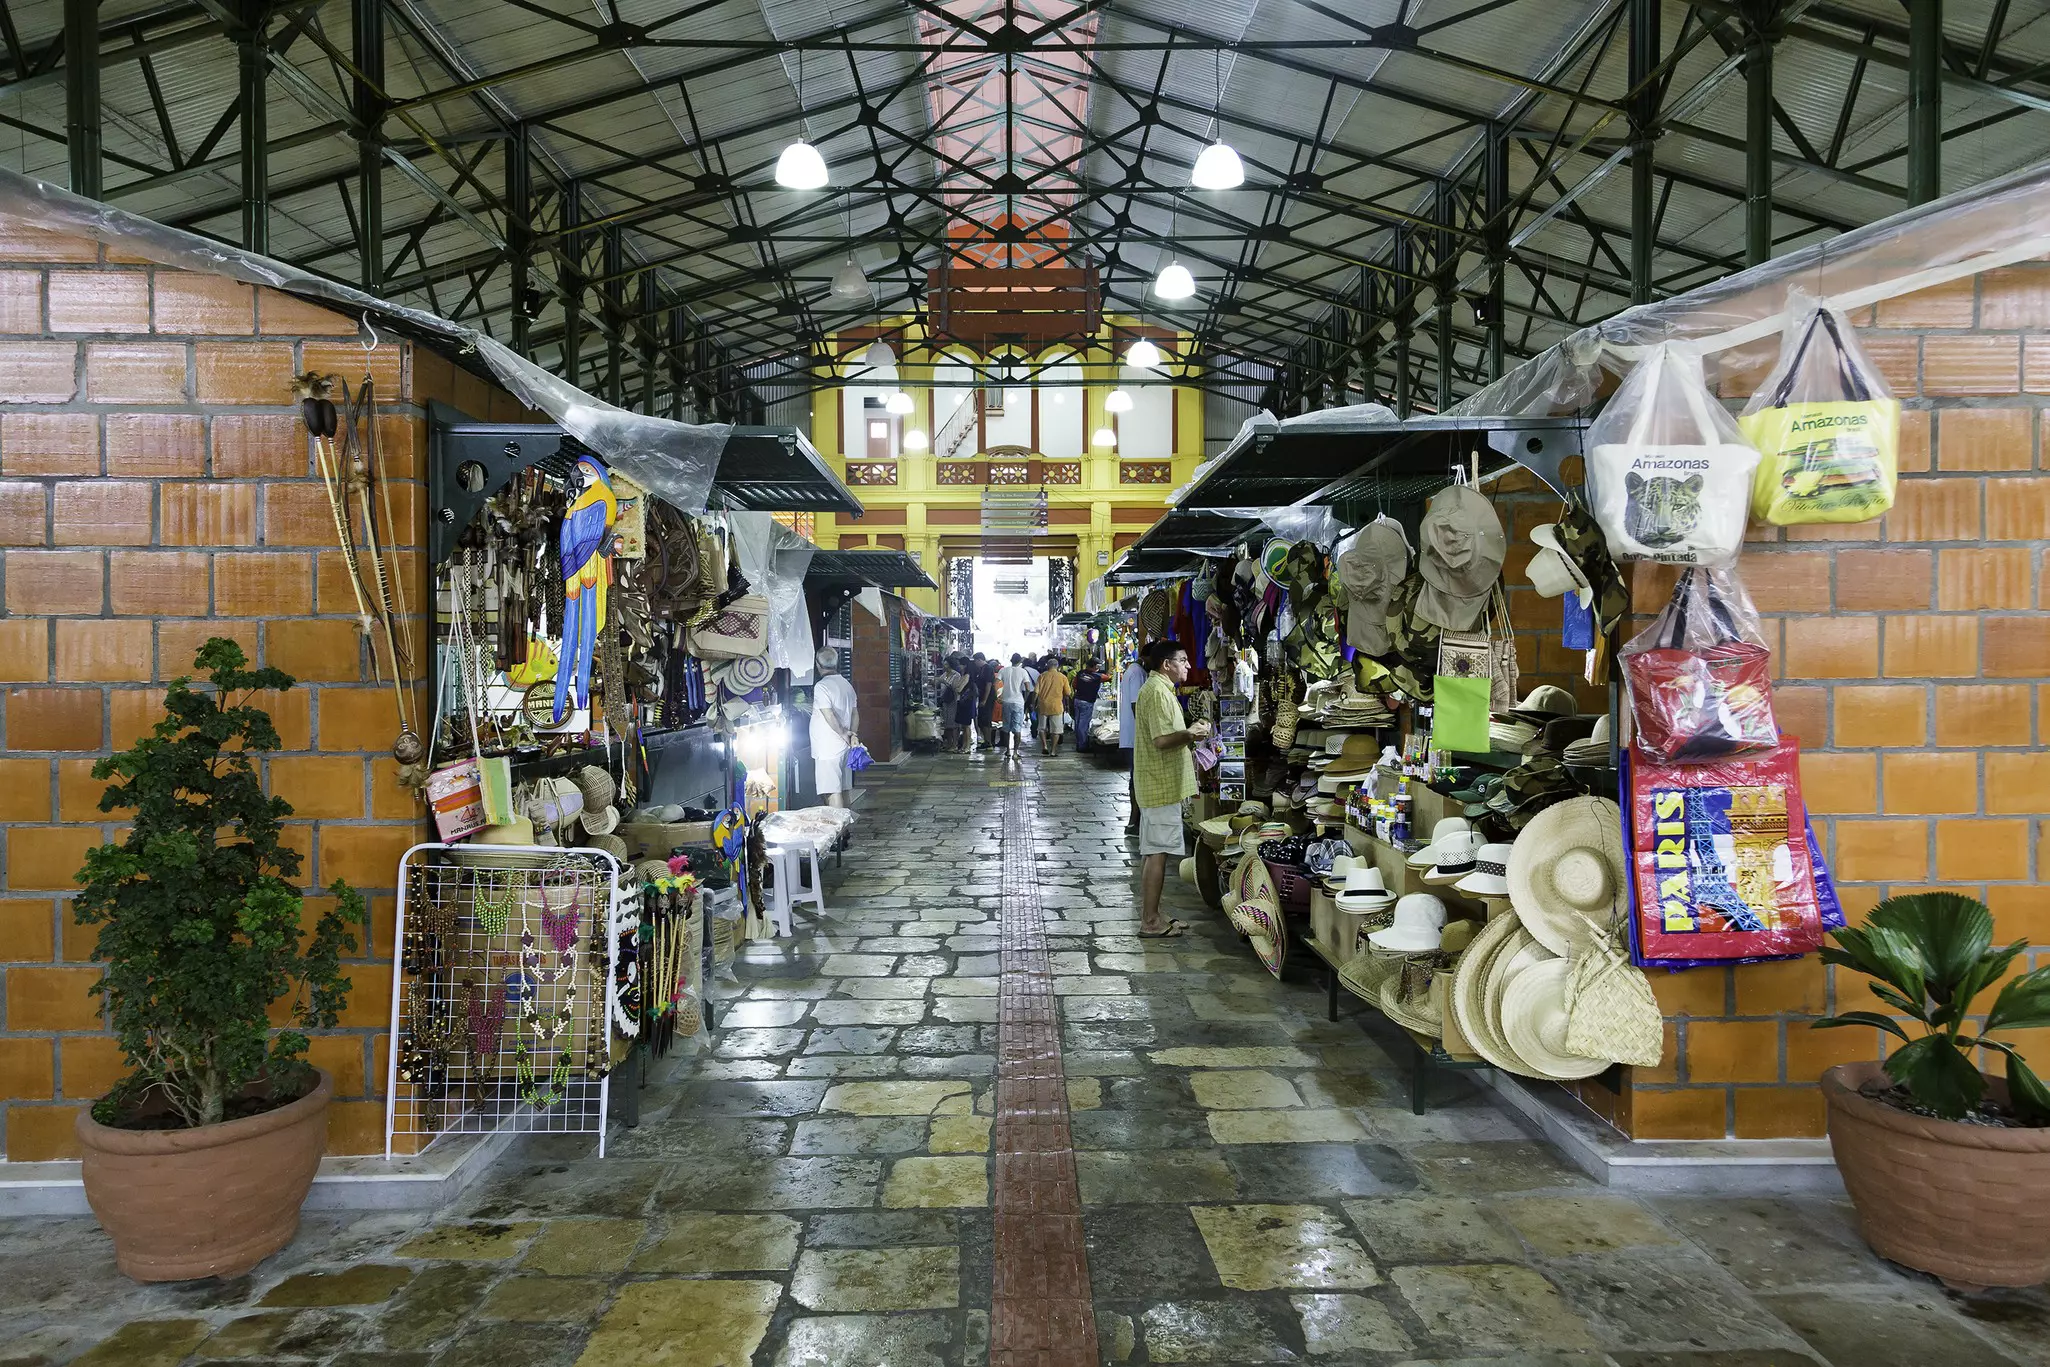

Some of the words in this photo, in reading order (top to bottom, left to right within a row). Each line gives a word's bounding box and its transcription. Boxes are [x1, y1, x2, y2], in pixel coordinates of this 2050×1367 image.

[1791, 415, 1868, 433] Amazonas
[1631, 458, 1710, 469] Amazonas
[1654, 551, 1698, 563] Pintada
[451, 821, 479, 835] MANAUS
[1655, 791, 1694, 932] PARIS
